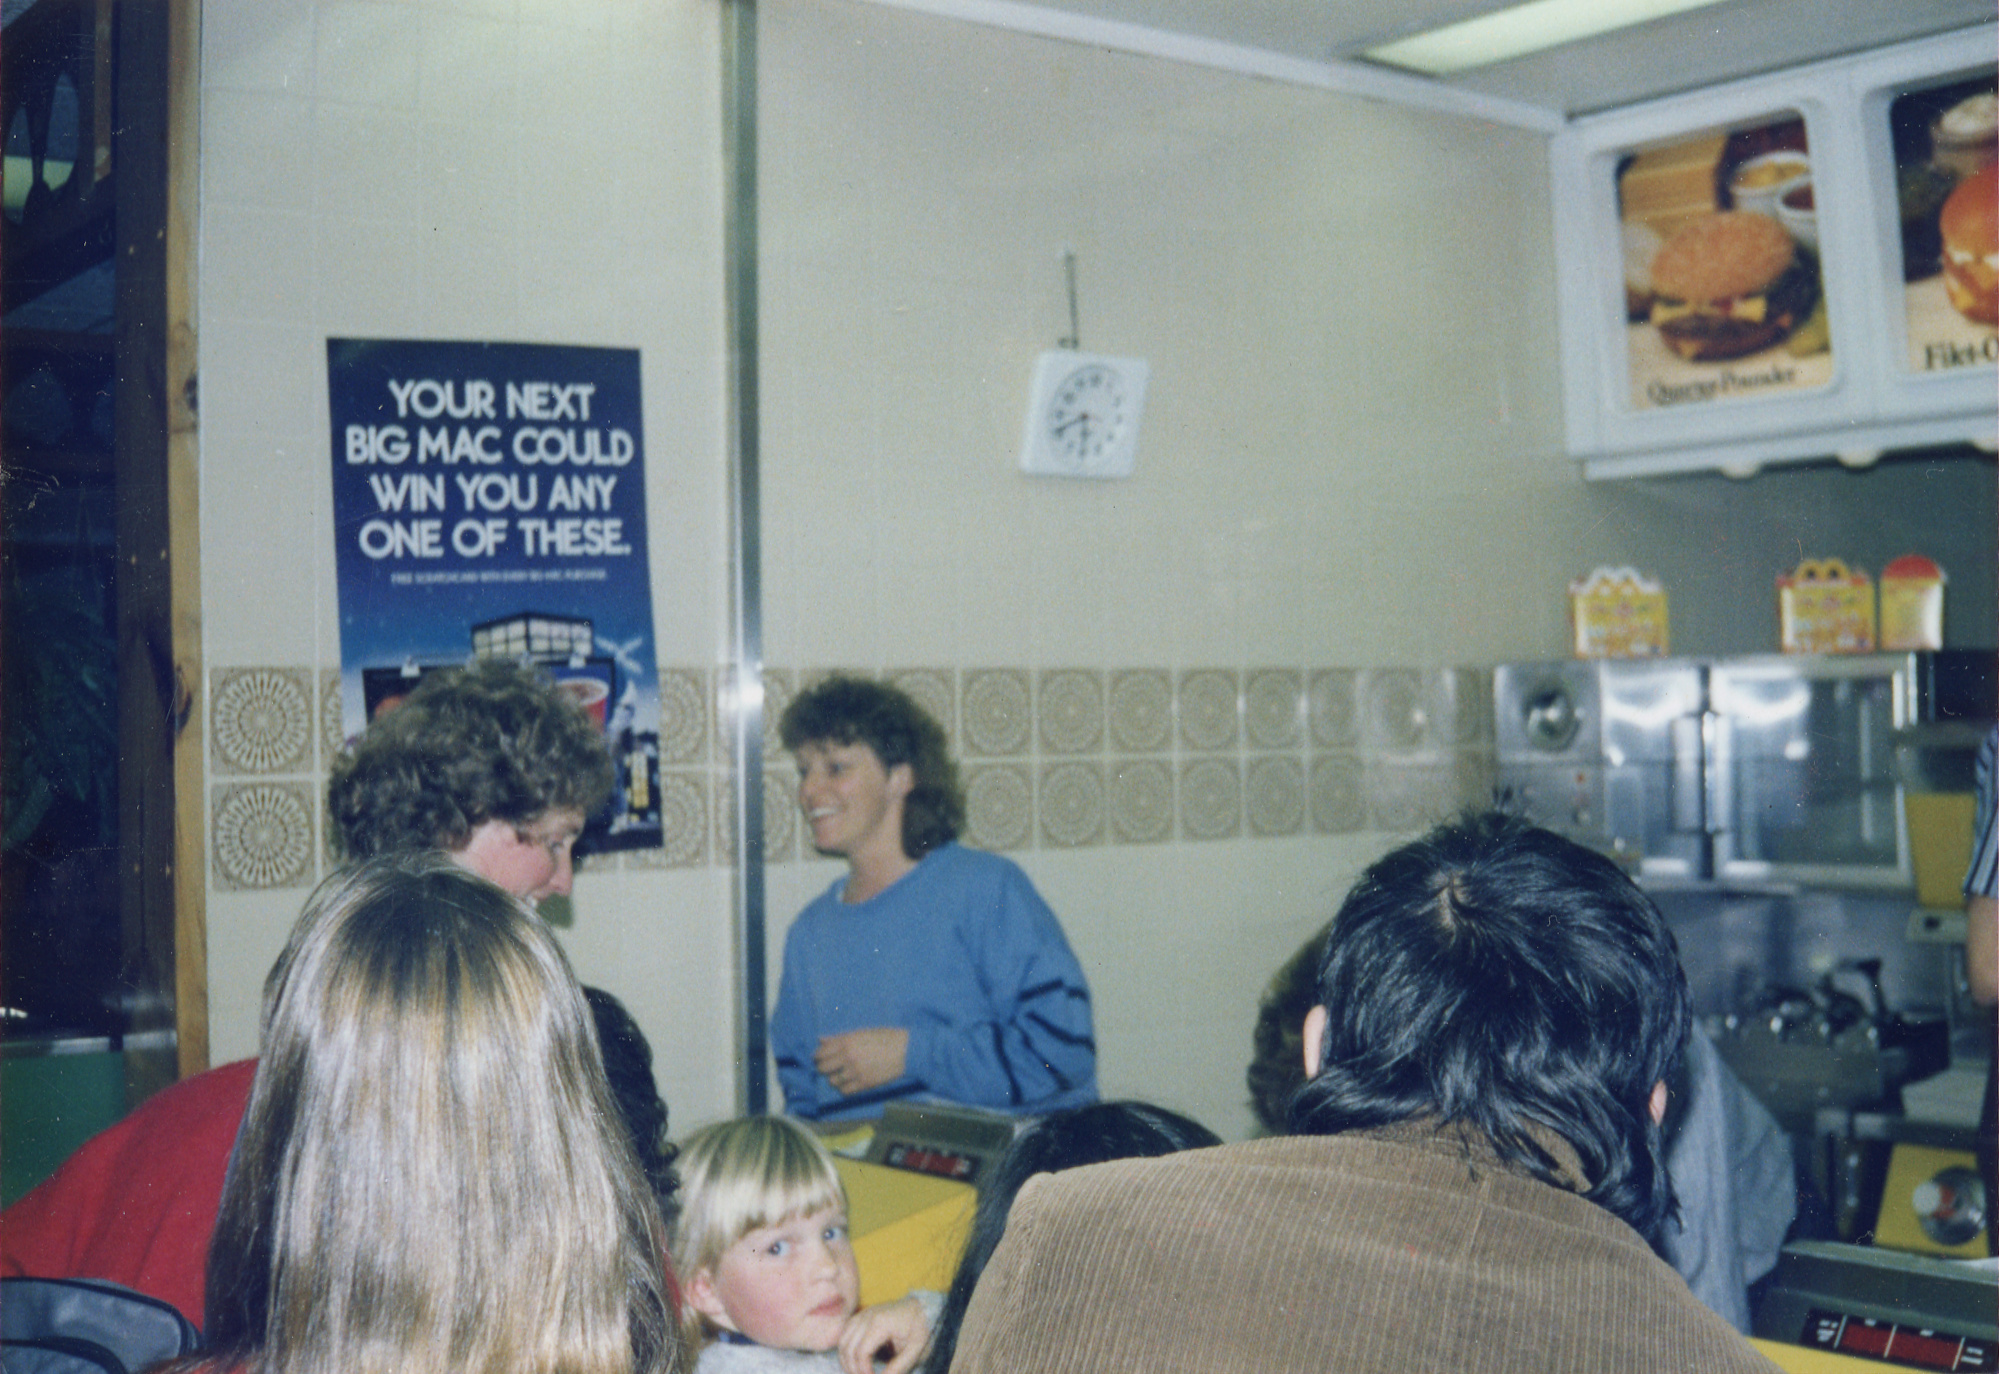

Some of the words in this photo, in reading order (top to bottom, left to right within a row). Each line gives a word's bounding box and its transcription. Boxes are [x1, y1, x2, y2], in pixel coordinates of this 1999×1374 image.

[389, 380, 496, 418] YOUR
[506, 382, 595, 421] NEXT
[346, 425, 411, 464] BIG
[418, 426, 503, 464] MAC
[513, 427, 634, 466] COULD
[370, 474, 445, 511] WIN
[456, 473, 538, 511] YOU
[548, 475, 617, 511] ANY
[359, 520, 444, 559] ONE
[452, 519, 508, 557] OF
[518, 518, 631, 556] THESE.
